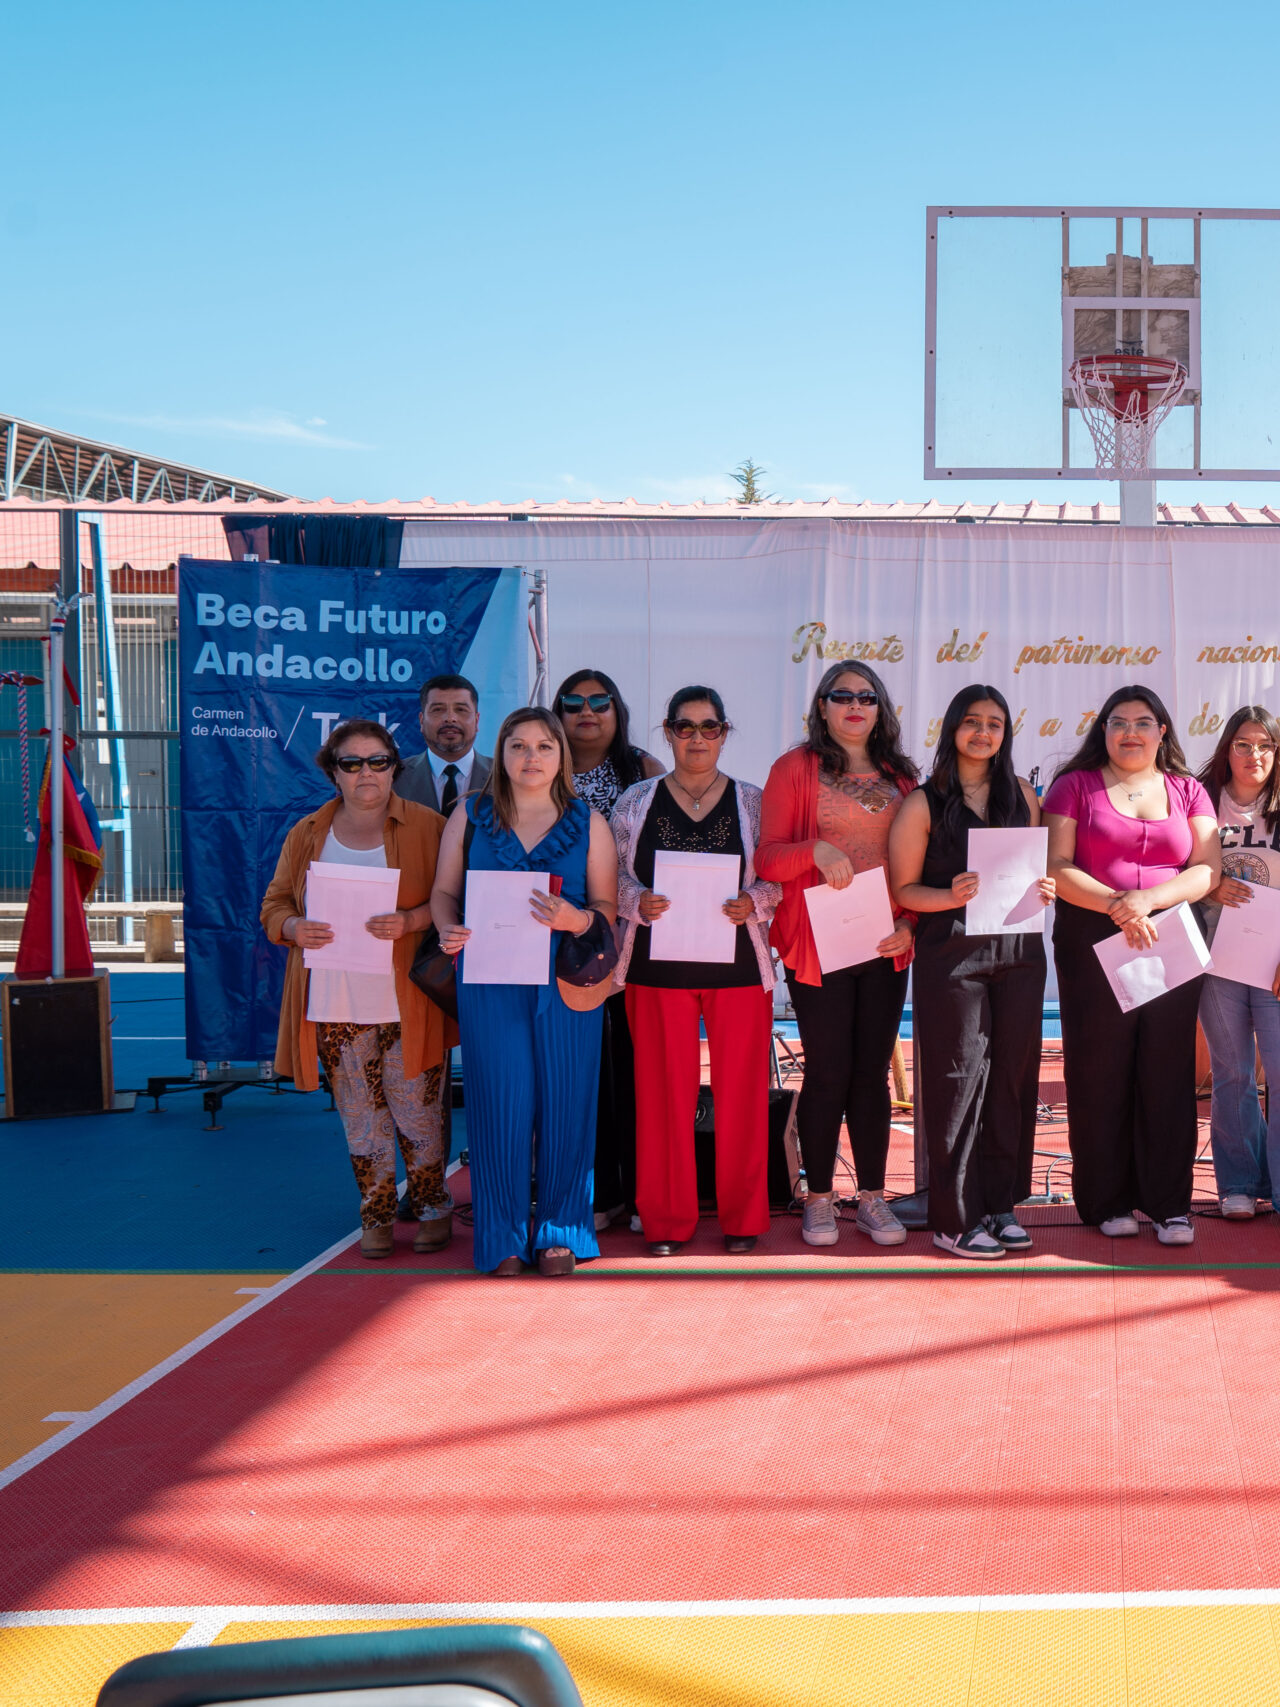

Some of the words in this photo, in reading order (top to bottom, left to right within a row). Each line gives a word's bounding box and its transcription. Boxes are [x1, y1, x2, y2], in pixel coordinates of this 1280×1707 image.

[197, 593, 307, 632] Beca
[319, 599, 447, 635] Futuro
[193, 641, 413, 683] Andacollo
[792, 622, 904, 663] Rescate
[936, 628, 988, 663] del
[191, 724, 209, 736] de
[211, 724, 278, 739] Andacollo
[192, 706, 244, 720] Carmen
